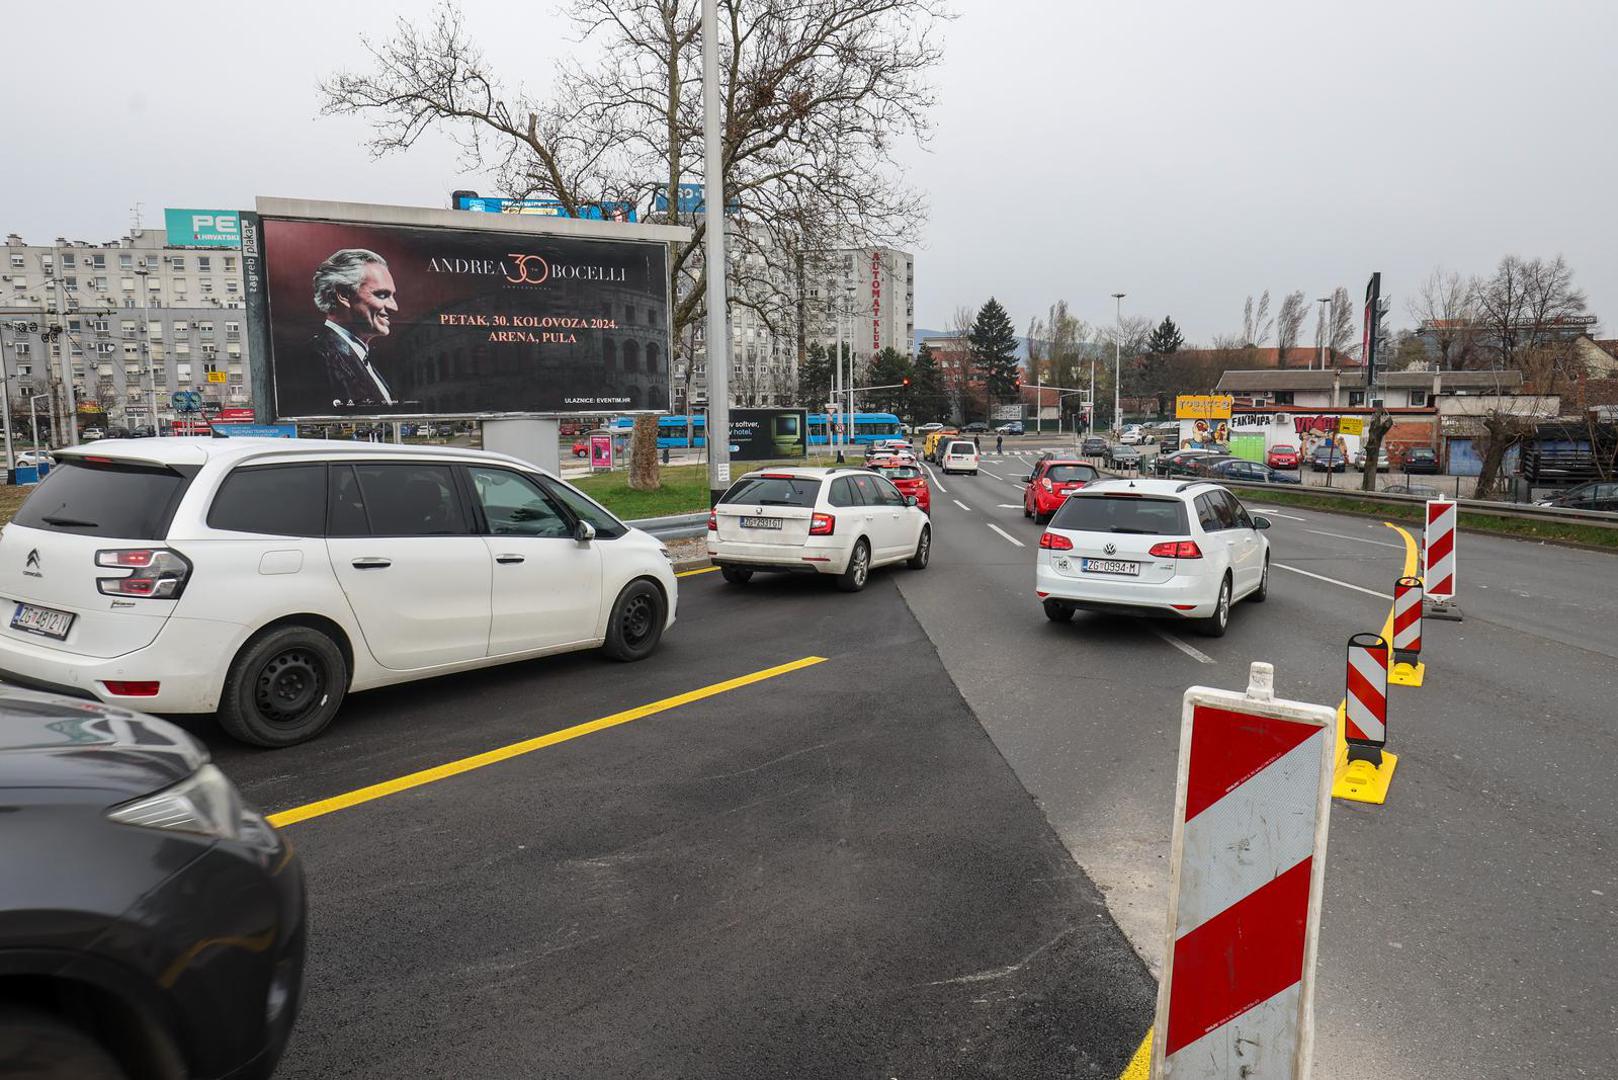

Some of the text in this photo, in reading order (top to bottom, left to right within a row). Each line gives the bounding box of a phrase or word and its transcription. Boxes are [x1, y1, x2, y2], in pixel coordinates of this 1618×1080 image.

[243, 223, 258, 293] zagreb plakat
[427, 253, 626, 284] ANDREA 30 BOCELLI
[872, 252, 880, 317] AUTOMAT
[439, 314, 619, 329] PETAK, 30. KOLOVOZA 2024.
[488, 331, 577, 343] ARENA, PULA
[735, 420, 760, 428] softver,
[1088, 559, 1099, 571] ZG
